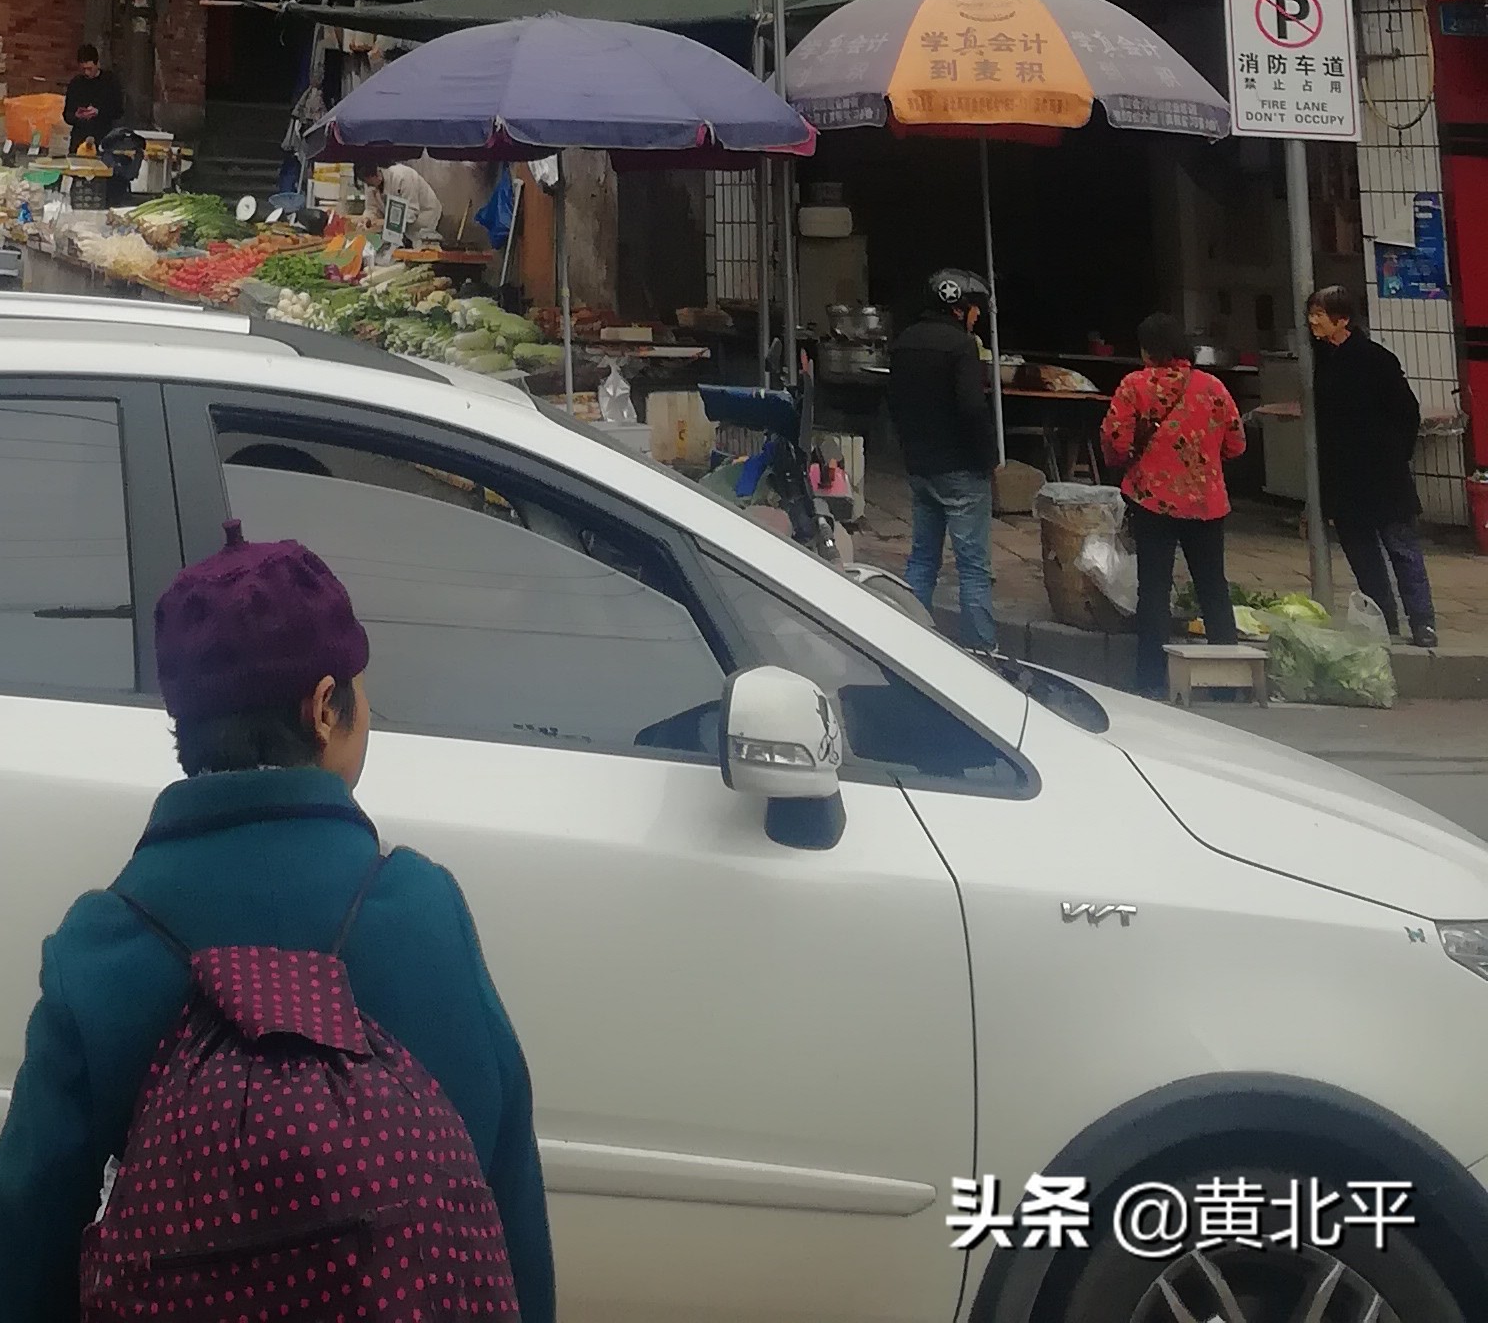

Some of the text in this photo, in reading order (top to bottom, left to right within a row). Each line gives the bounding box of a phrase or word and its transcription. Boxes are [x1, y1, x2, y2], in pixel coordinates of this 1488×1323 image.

[920, 26, 1048, 56] 学真会计
[929, 58, 1046, 84] 到麦积
[1238, 52, 1346, 78] 消防车道
[1244, 77, 1342, 94] 禁止占用
[1261, 99, 1328, 113] FIRE LANE
[1245, 111, 1345, 126] DON'T OCCUPY
